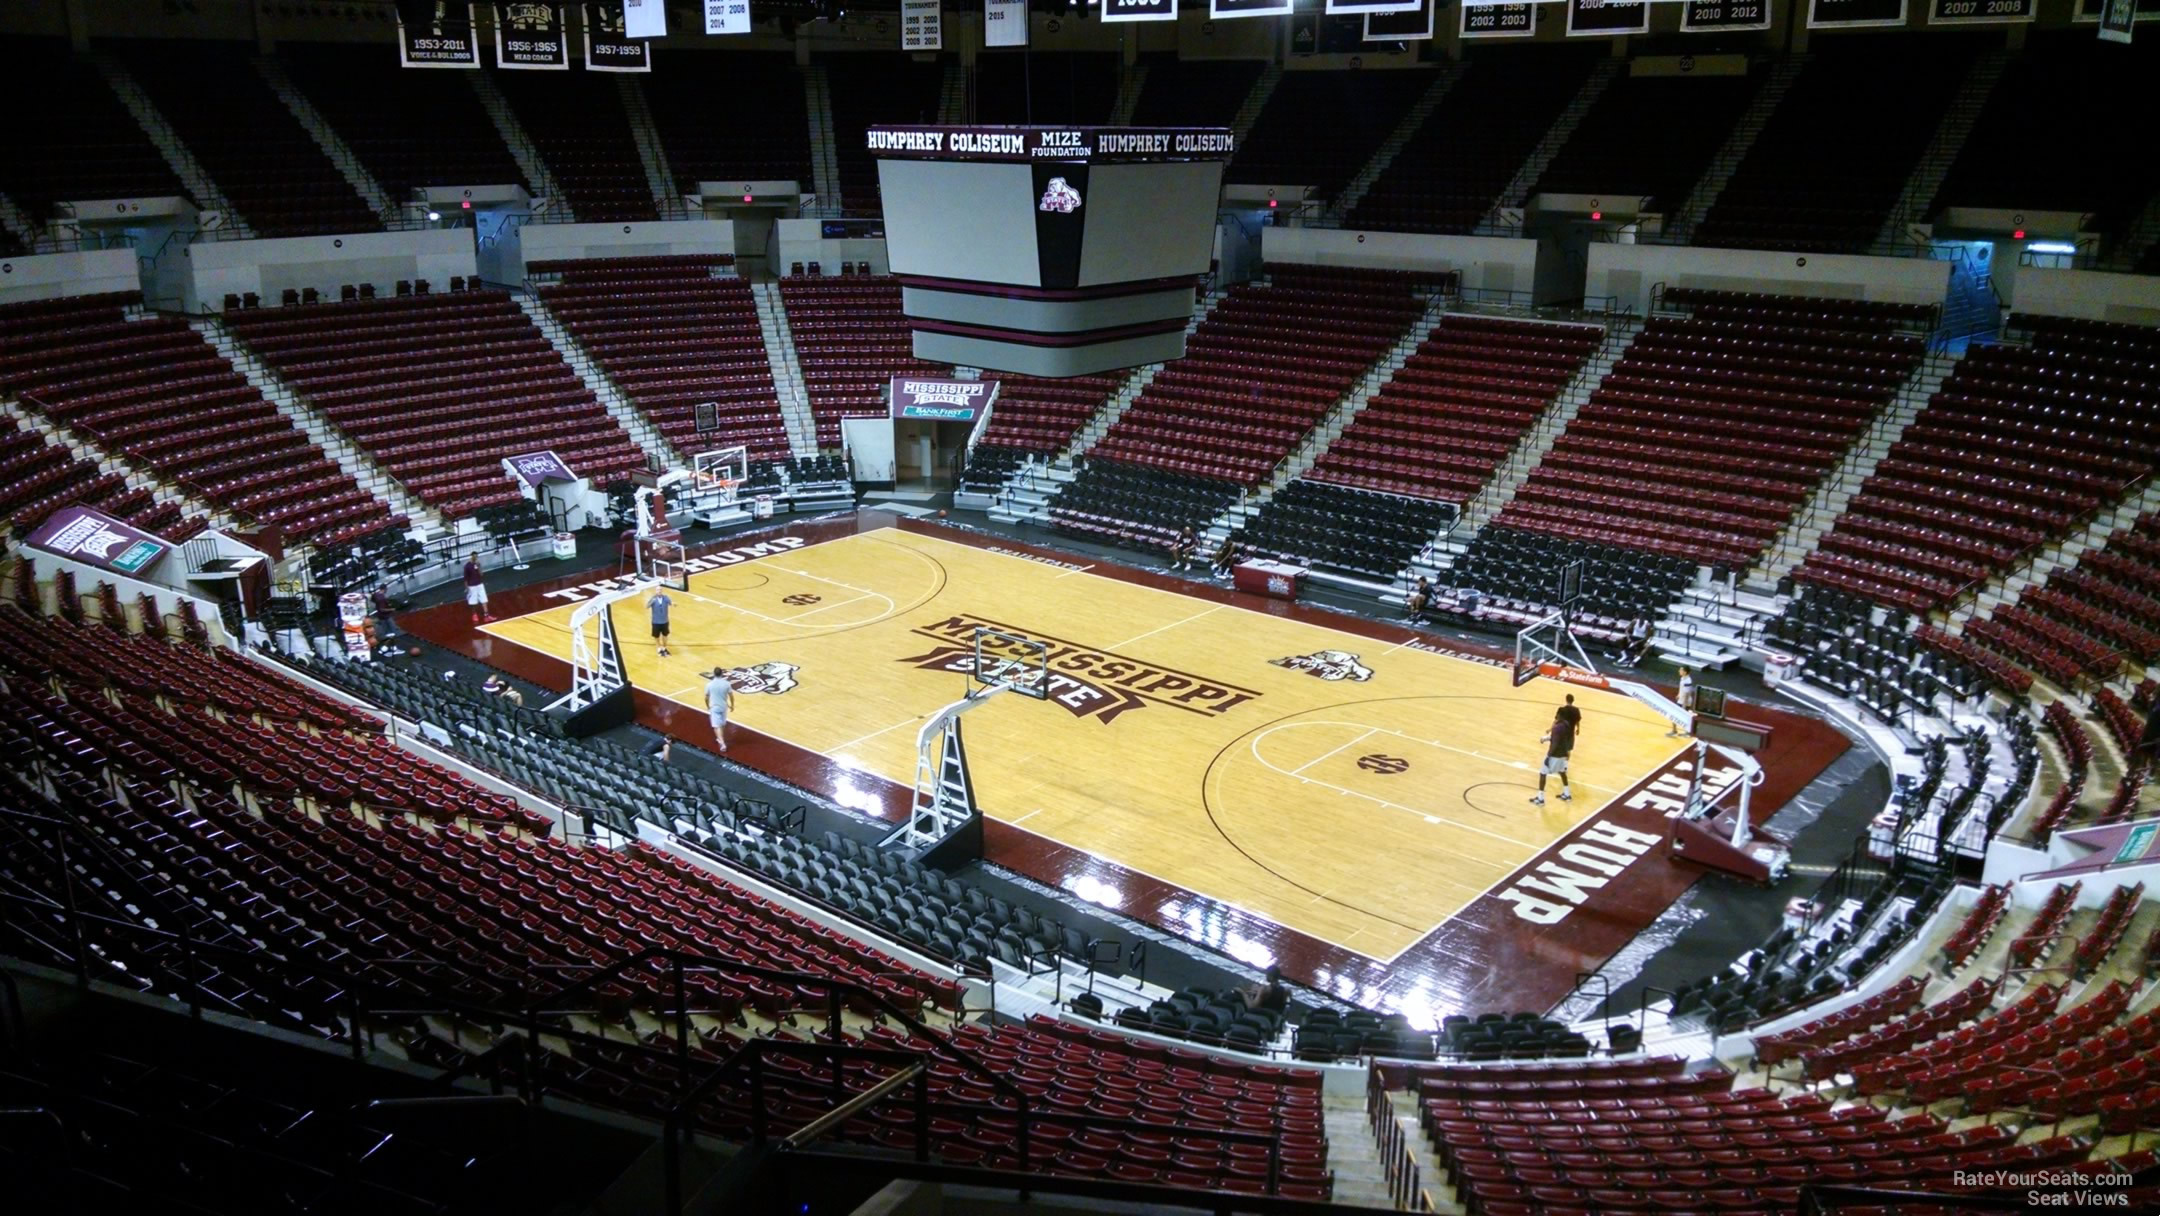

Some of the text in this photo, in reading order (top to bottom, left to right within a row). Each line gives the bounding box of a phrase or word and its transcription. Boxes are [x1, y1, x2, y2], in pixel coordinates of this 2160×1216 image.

[709, 5, 724, 15] 2007
[1695, 6, 1758, 20] 2010 2012
[1944, 2, 1977, 14] 2007
[989, 11, 1004, 20] 2015
[1471, 15, 1526, 26] 2002 2003
[414, 39, 466, 50] 1953-2011
[507, 41, 558, 52] 1956-1965
[595, 45, 641, 55] 1957-1959
[867, 131, 1025, 154] HUMPHREY COLISEUM
[1041, 132, 1082, 146] MIZE
[1098, 134, 1234, 153] HUMPHREY COLISEUM
[1031, 147, 1092, 157] FOUNDATION
[904, 383, 984, 395] MISSISSIPPI
[671, 537, 806, 573] HUMP
[781, 593, 822, 606] SEC
[921, 616, 1254, 714] MISSISSIPPI
[945, 657, 1101, 708] STATE
[1632, 691, 1688, 728] MISSISSIPPI STATE
[1356, 754, 1410, 774] SEC
[1498, 820, 1663, 925] HUMP
